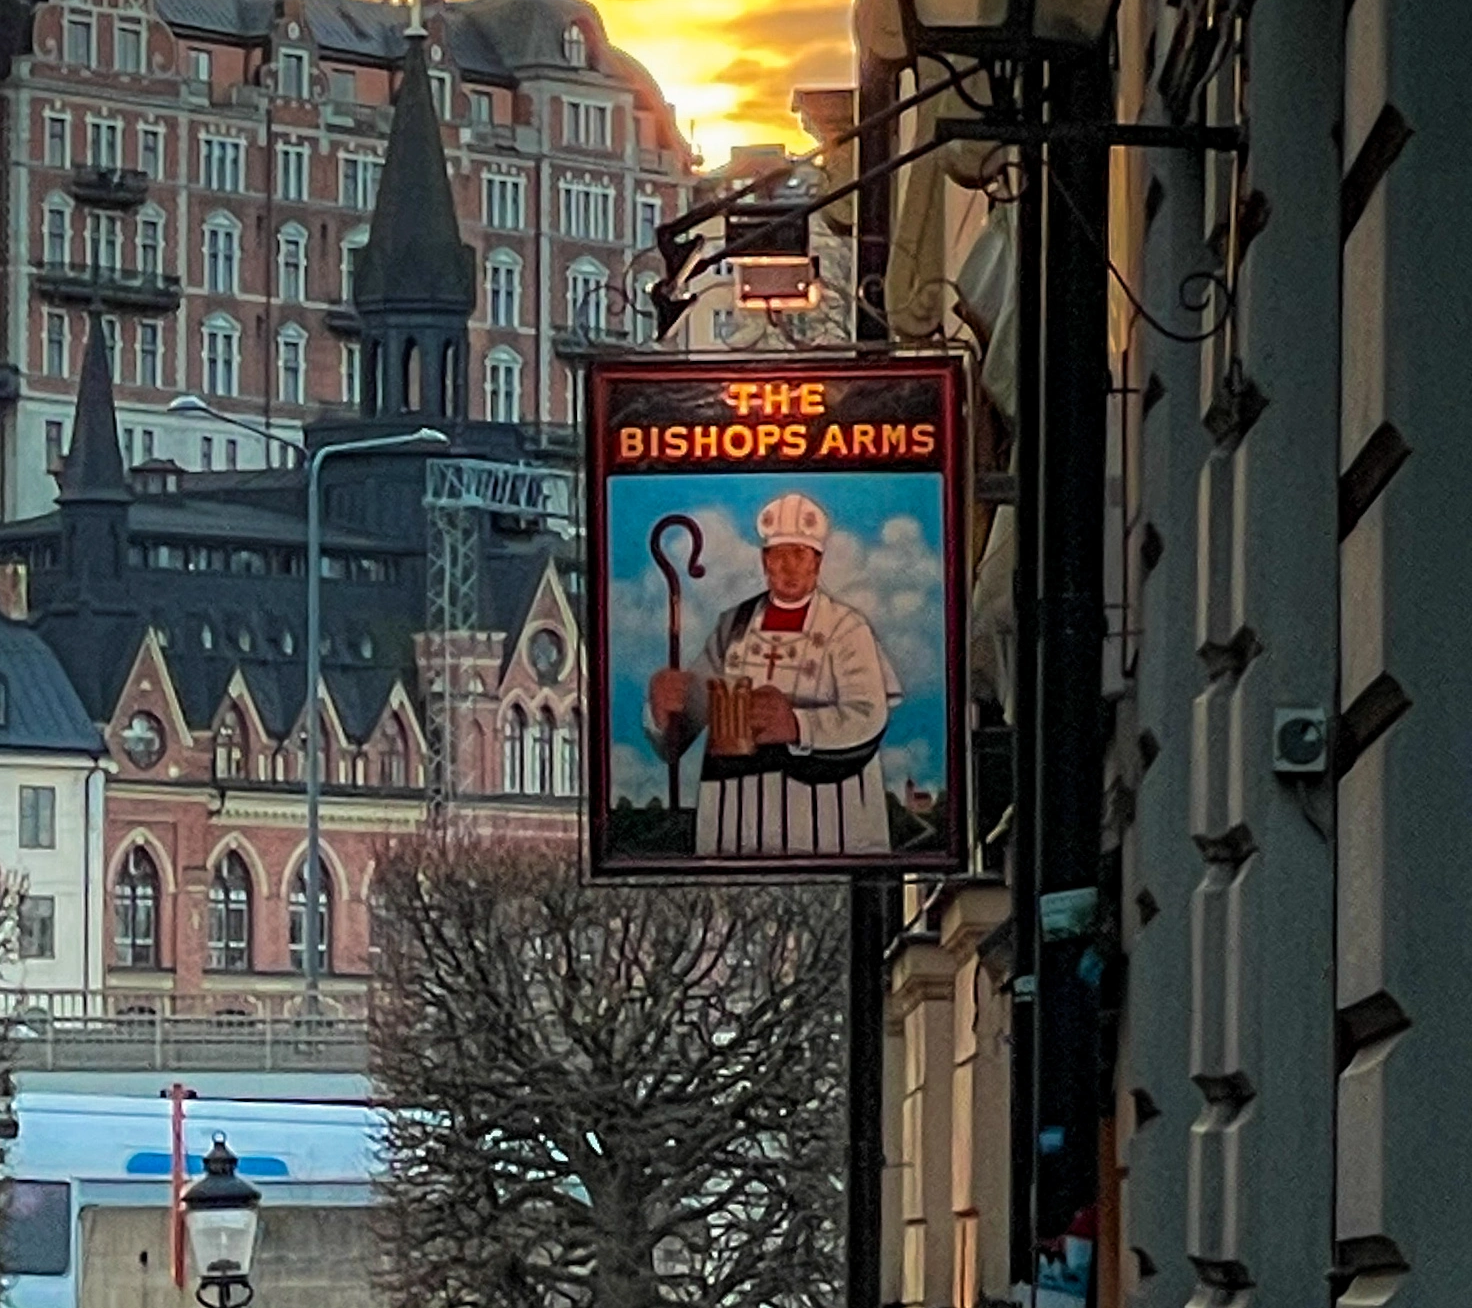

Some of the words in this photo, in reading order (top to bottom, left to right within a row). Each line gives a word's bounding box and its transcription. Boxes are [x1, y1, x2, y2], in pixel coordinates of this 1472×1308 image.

[729, 382, 825, 417] THE
[619, 424, 807, 458] BISHOPS
[819, 424, 936, 456] ARMS
